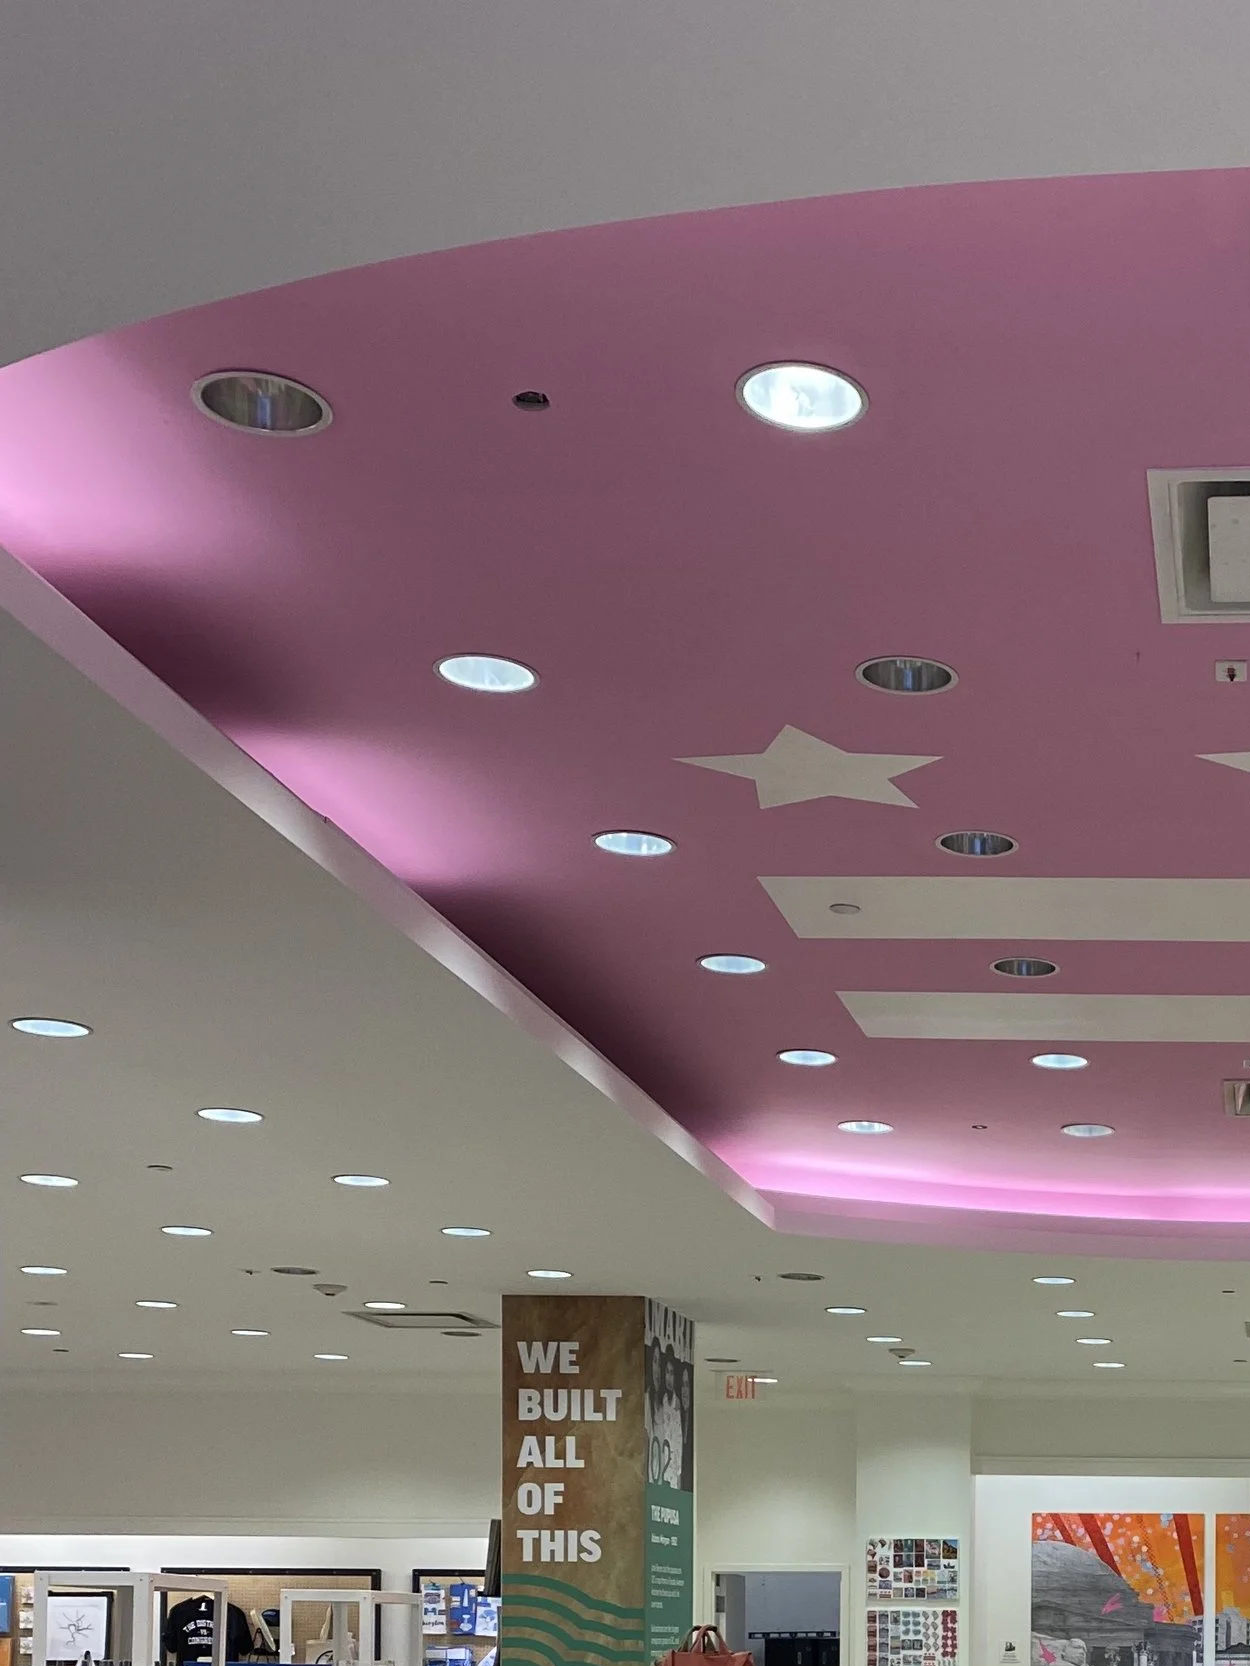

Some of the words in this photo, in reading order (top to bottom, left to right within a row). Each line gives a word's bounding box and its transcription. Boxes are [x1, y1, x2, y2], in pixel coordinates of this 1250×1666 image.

[517, 1341, 580, 1374] WE
[725, 1375, 758, 1400] EXIT
[518, 1388, 622, 1421] BUILT
[516, 1435, 585, 1468] ALL
[516, 1482, 565, 1516] OF
[516, 1529, 602, 1563] THIS
